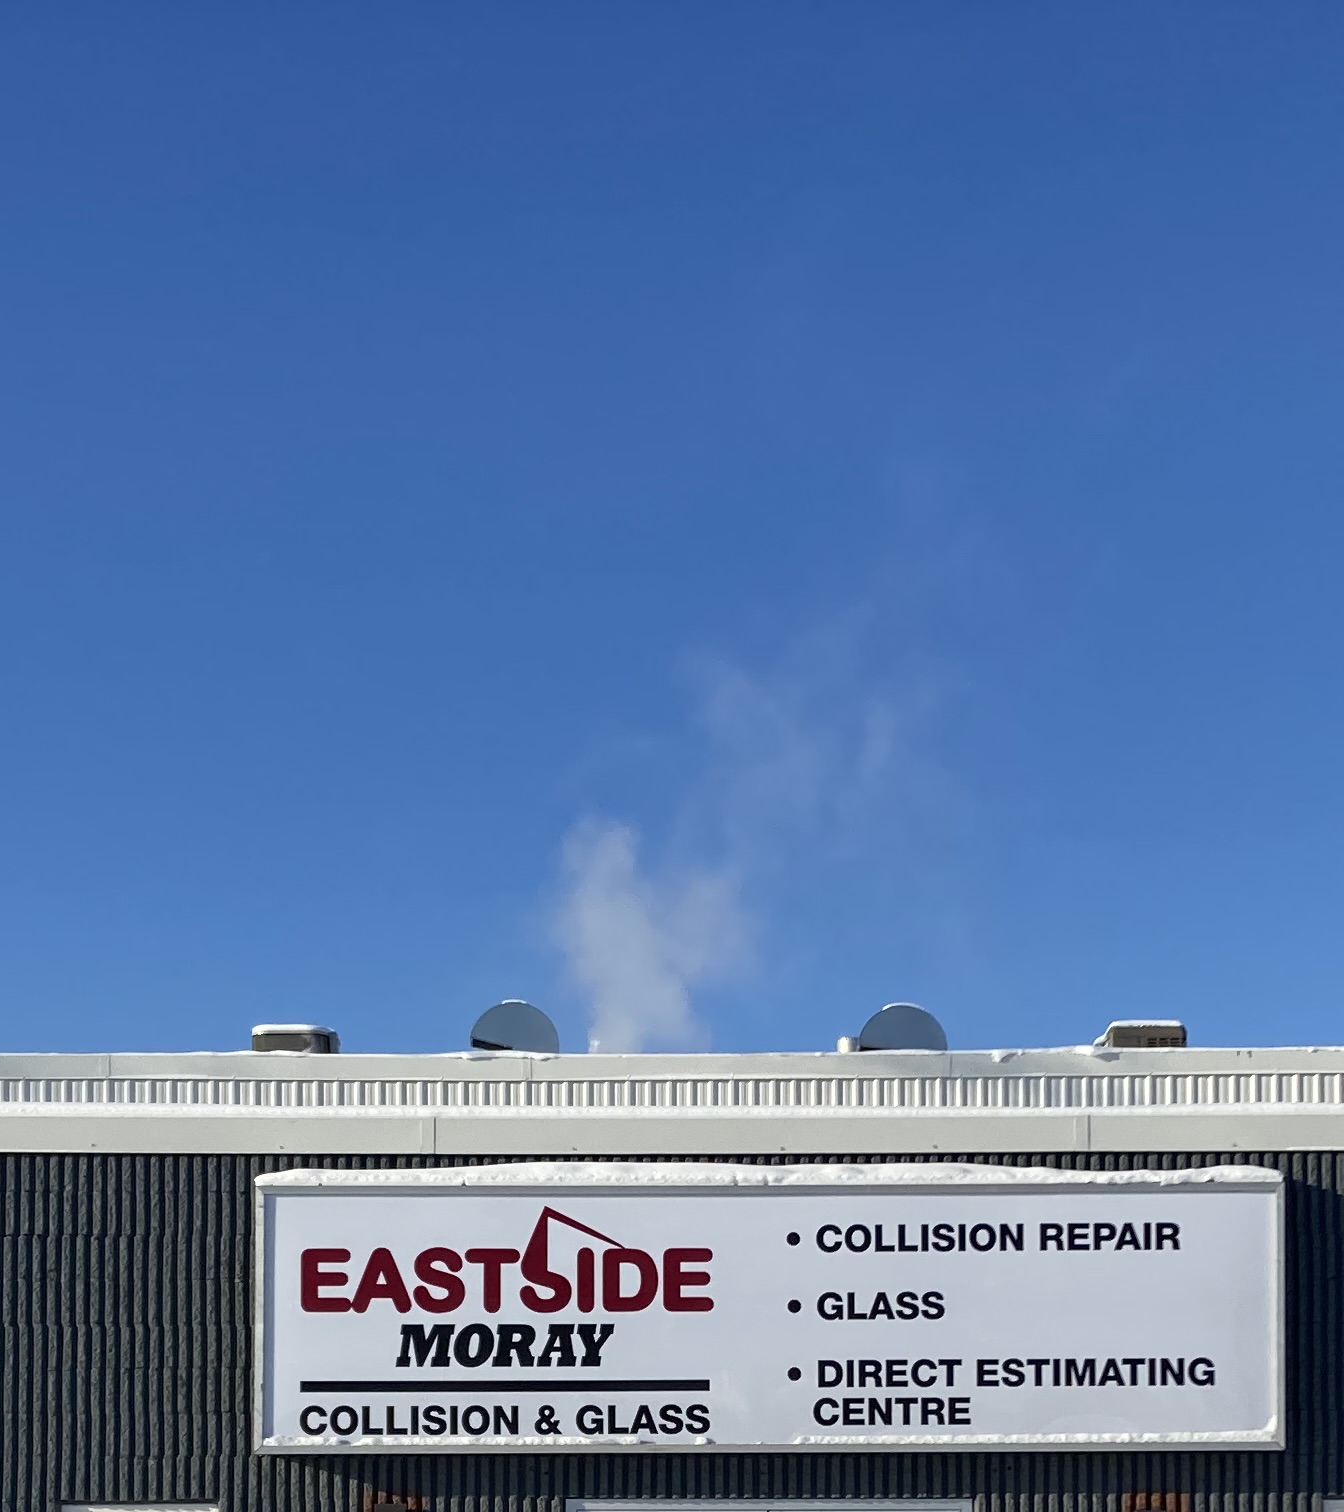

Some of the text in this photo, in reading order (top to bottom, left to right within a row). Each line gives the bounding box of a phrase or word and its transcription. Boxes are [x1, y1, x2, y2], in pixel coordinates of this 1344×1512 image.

[816, 1222, 1181, 1252] COLLISION REPAIR
[301, 1207, 715, 1313] EASTSIDE
[816, 1291, 945, 1320] GLASS
[395, 1323, 615, 1368] MORAY
[817, 1357, 1215, 1388] DIRECT ESTIMATING
[299, 1403, 711, 1436] COLLISION & GLASS
[812, 1397, 972, 1427] CENTRE
